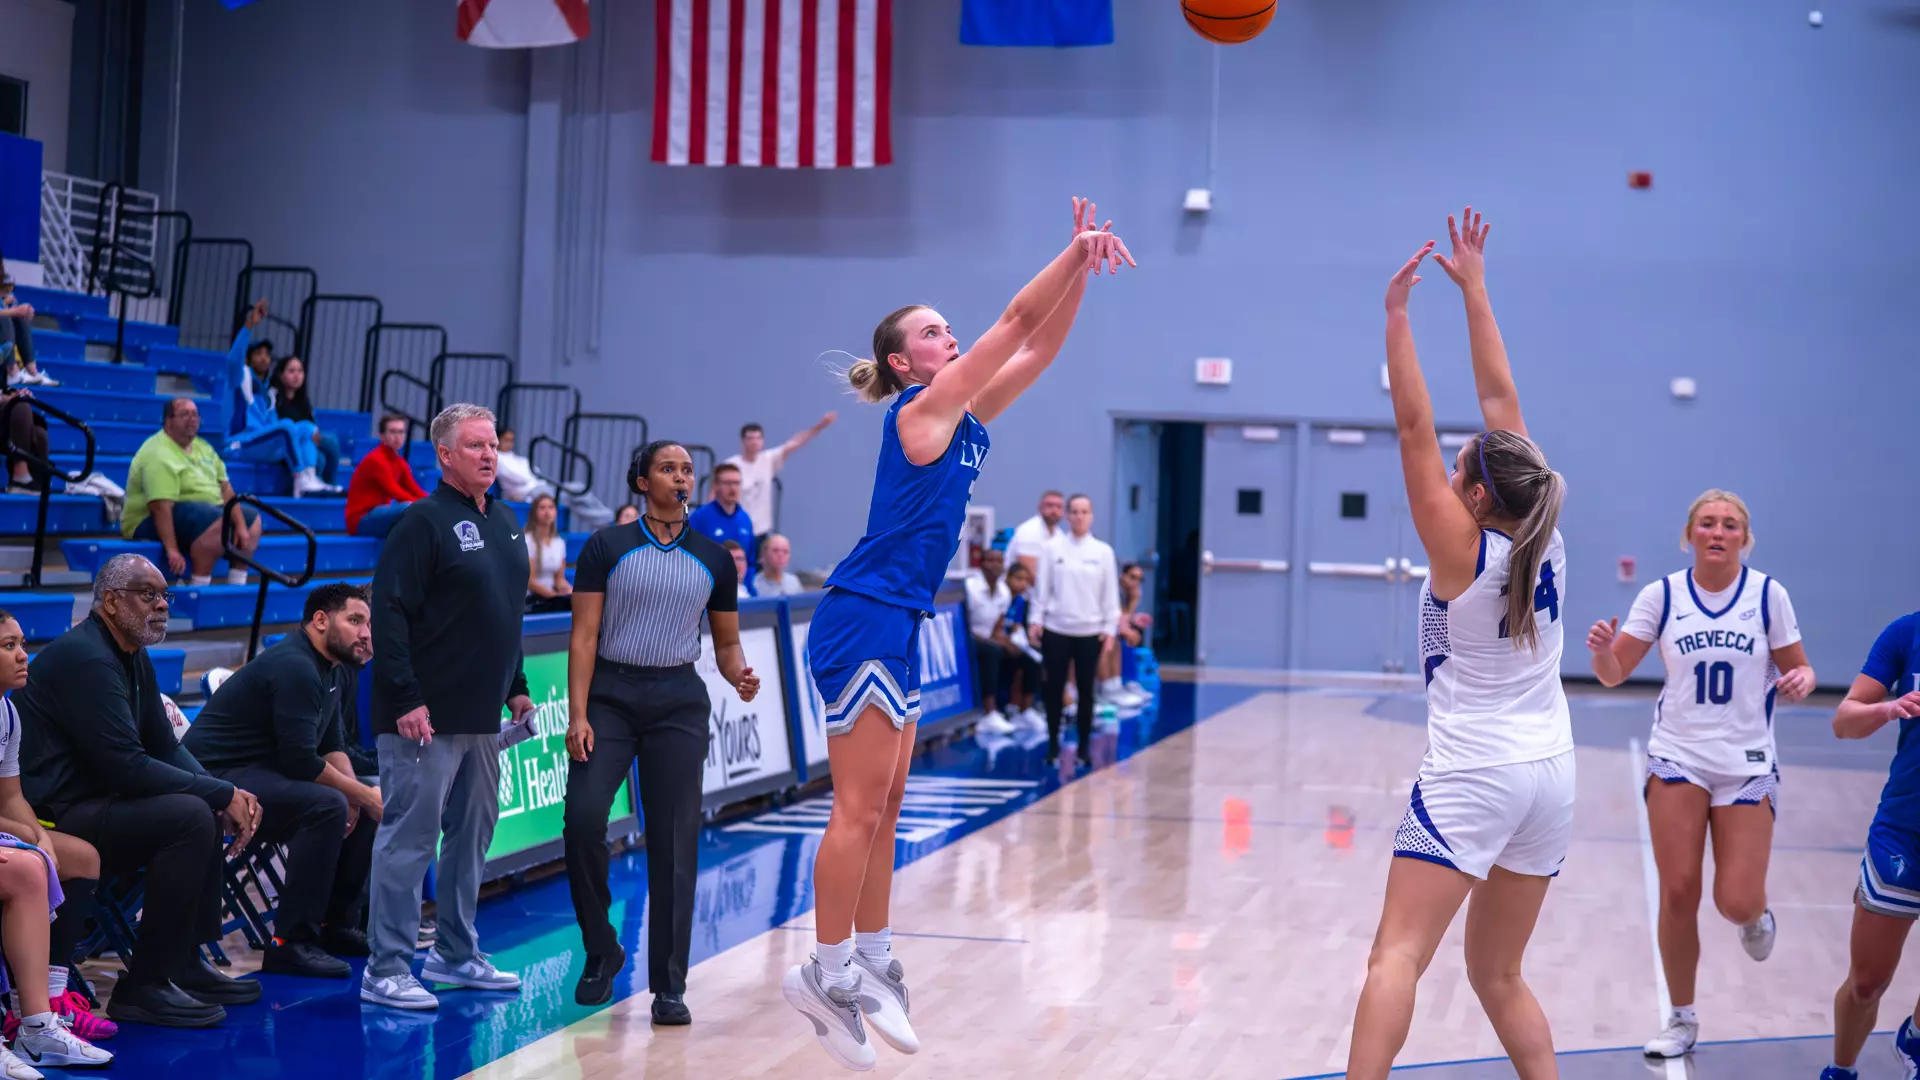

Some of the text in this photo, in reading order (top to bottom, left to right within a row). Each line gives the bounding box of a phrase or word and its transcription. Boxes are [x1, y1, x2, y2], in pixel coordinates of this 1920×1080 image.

[1498, 559, 1559, 639] 4
[1675, 630, 1755, 656] TREVECCA
[1694, 661, 1734, 704] 10
[520, 684, 570, 753] aptist
